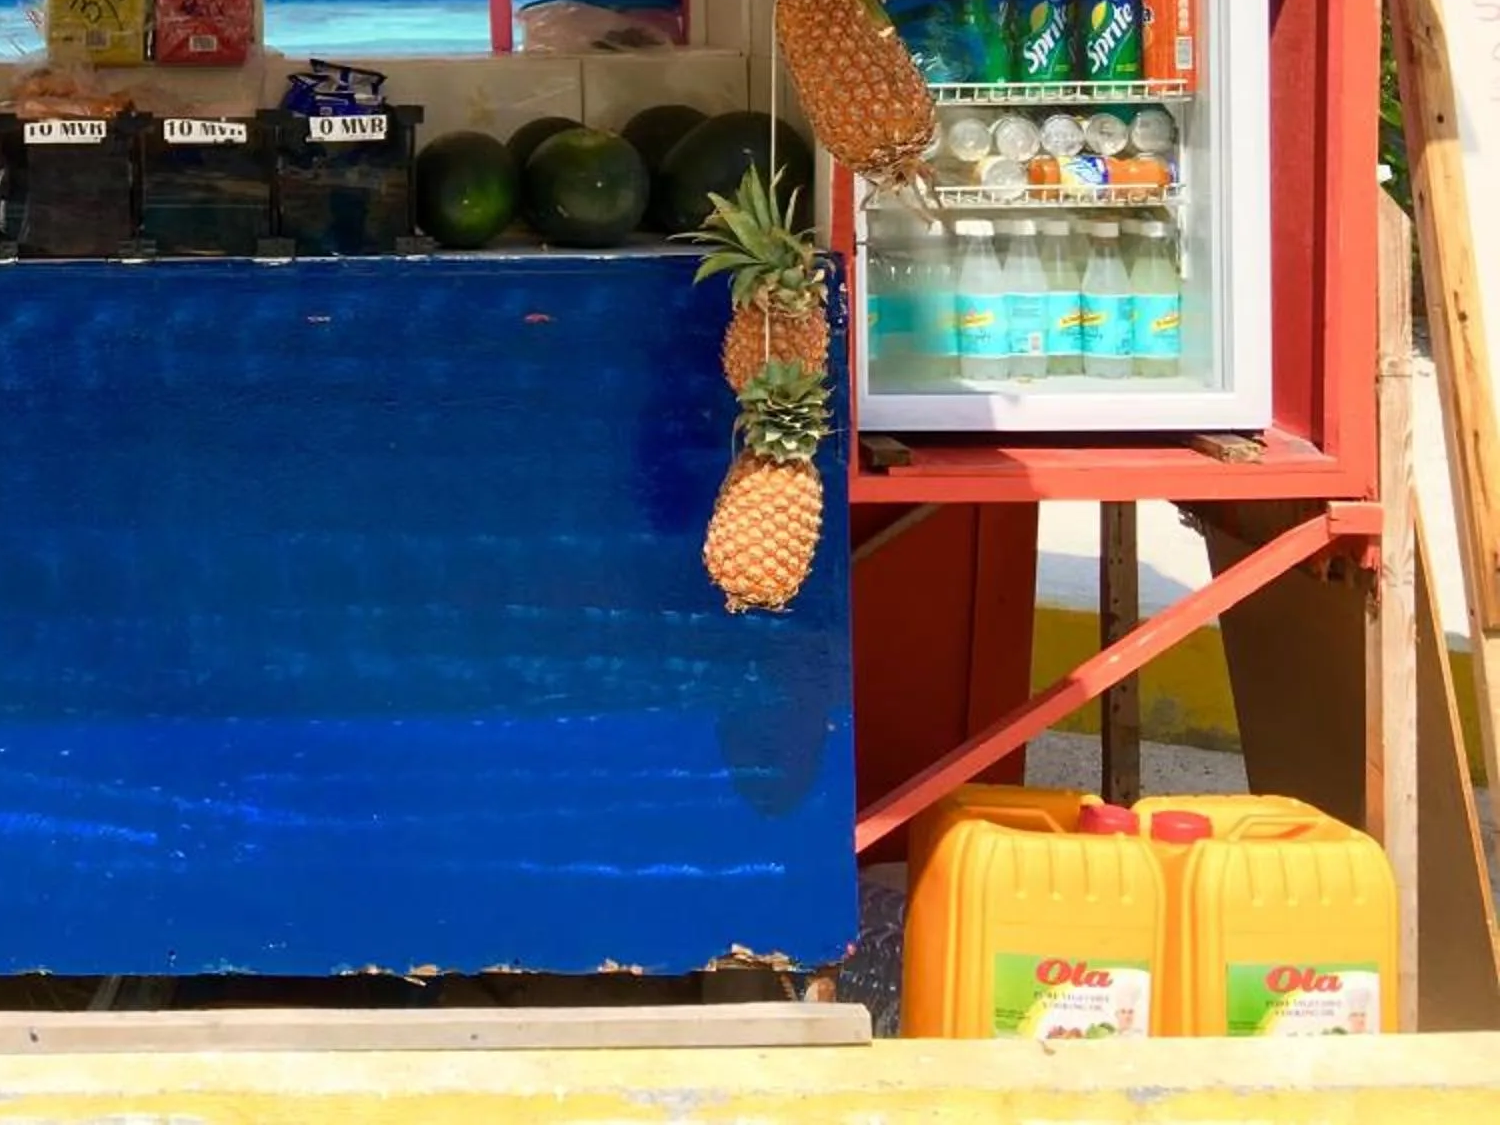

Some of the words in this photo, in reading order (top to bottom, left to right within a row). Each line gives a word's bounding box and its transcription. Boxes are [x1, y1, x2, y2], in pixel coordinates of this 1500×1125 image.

[1087, 3, 1133, 74] Sprite
[166, 121, 193, 137] 10
[342, 117, 384, 134] MVR
[1035, 958, 1113, 988] Ola
[1265, 965, 1343, 993] Ola
